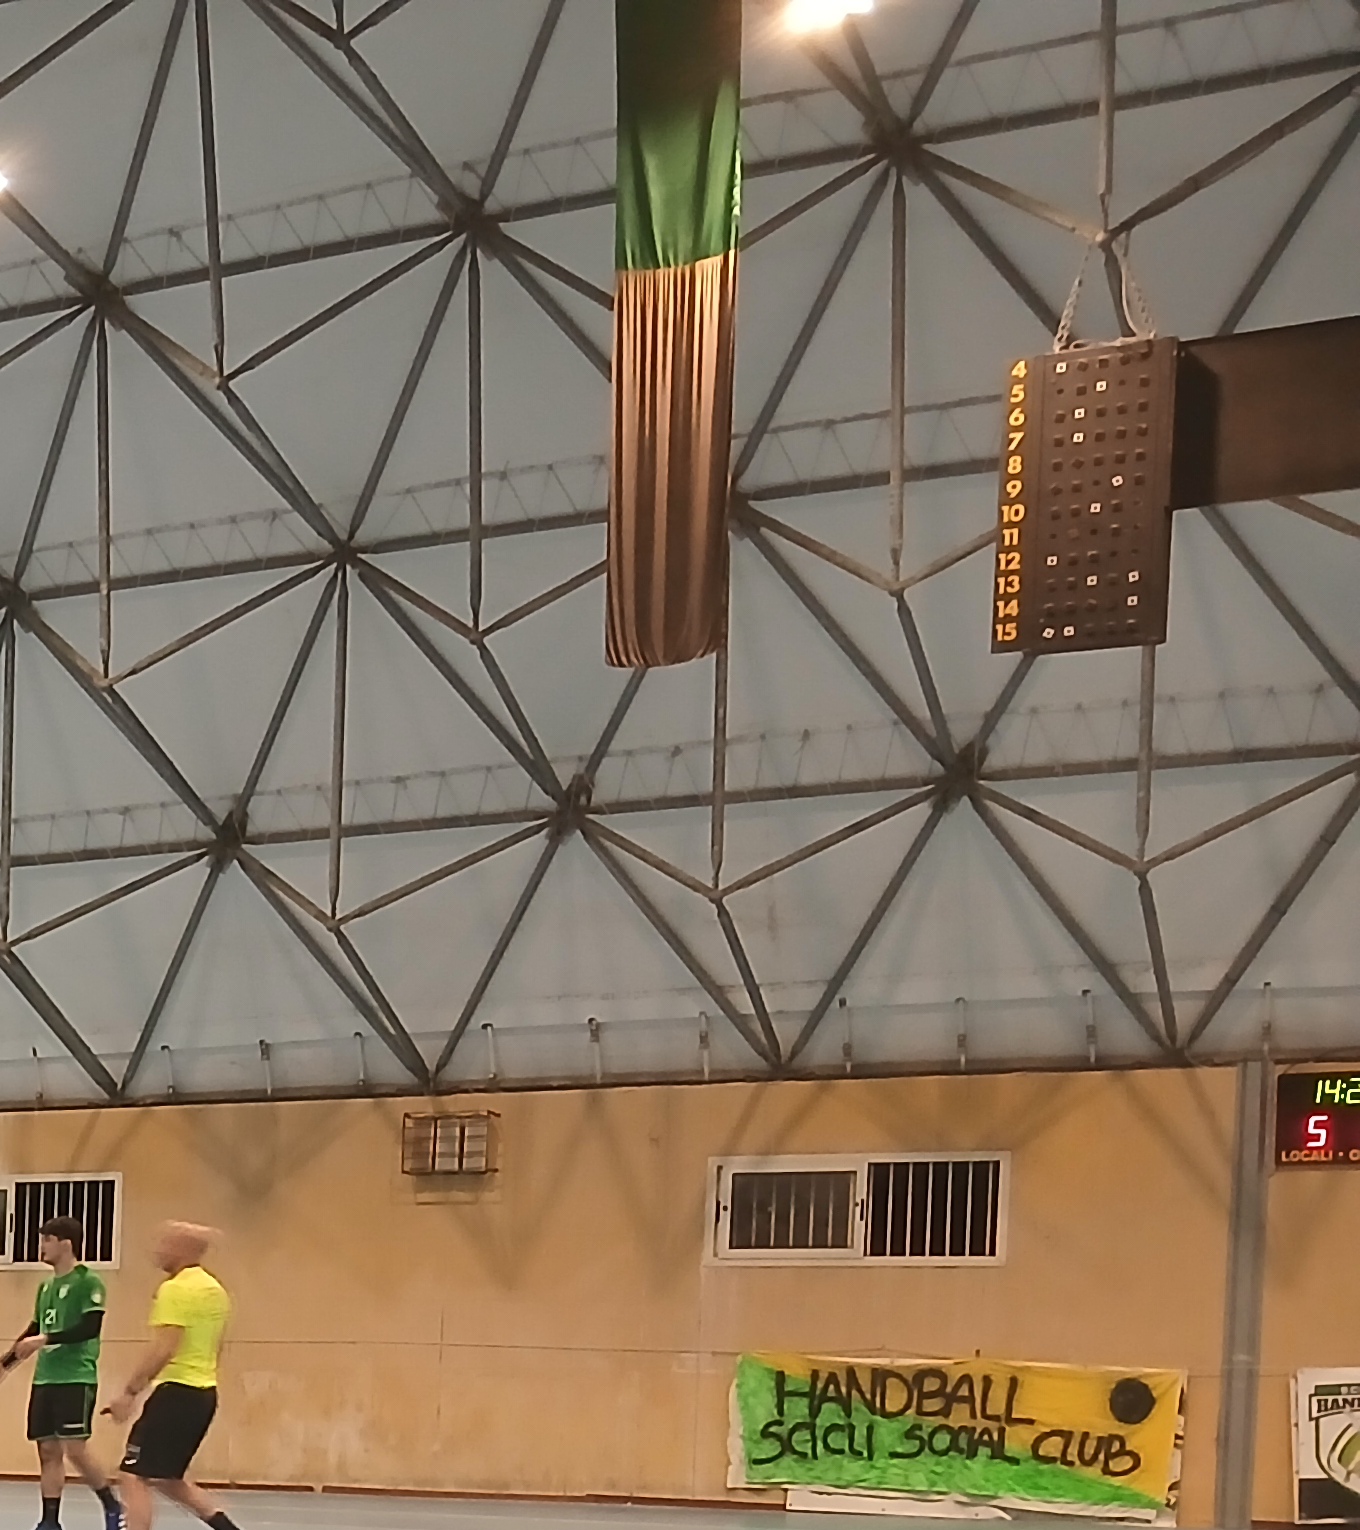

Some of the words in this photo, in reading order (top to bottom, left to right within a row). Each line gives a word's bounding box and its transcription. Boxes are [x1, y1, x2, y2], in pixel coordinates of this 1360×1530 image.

[1011, 360, 1027, 378] 4
[1010, 384, 1025, 403] 5
[1009, 408, 1025, 426] 6
[1008, 431, 1025, 451] 7
[1007, 455, 1022, 474] 8
[1006, 480, 1022, 499] 9
[1001, 503, 1025, 523] 10
[1002, 527, 1019, 546] 11
[998, 552, 1021, 571] 12
[997, 575, 1020, 595] 13
[996, 599, 1019, 618] 14
[995, 622, 1017, 642] 15
[1306, 1115, 1328, 1147] 5
[1281, 1150, 1333, 1162] LOCALI
[44, 1308, 57, 1325] 21
[775, 1365, 1037, 1425] HANDBALL
[1316, 1397, 1360, 1414] HAN
[751, 1419, 874, 1465] SCICLI
[889, 1423, 1020, 1466] SOCIAL
[1031, 1429, 1141, 1477] CLUB
